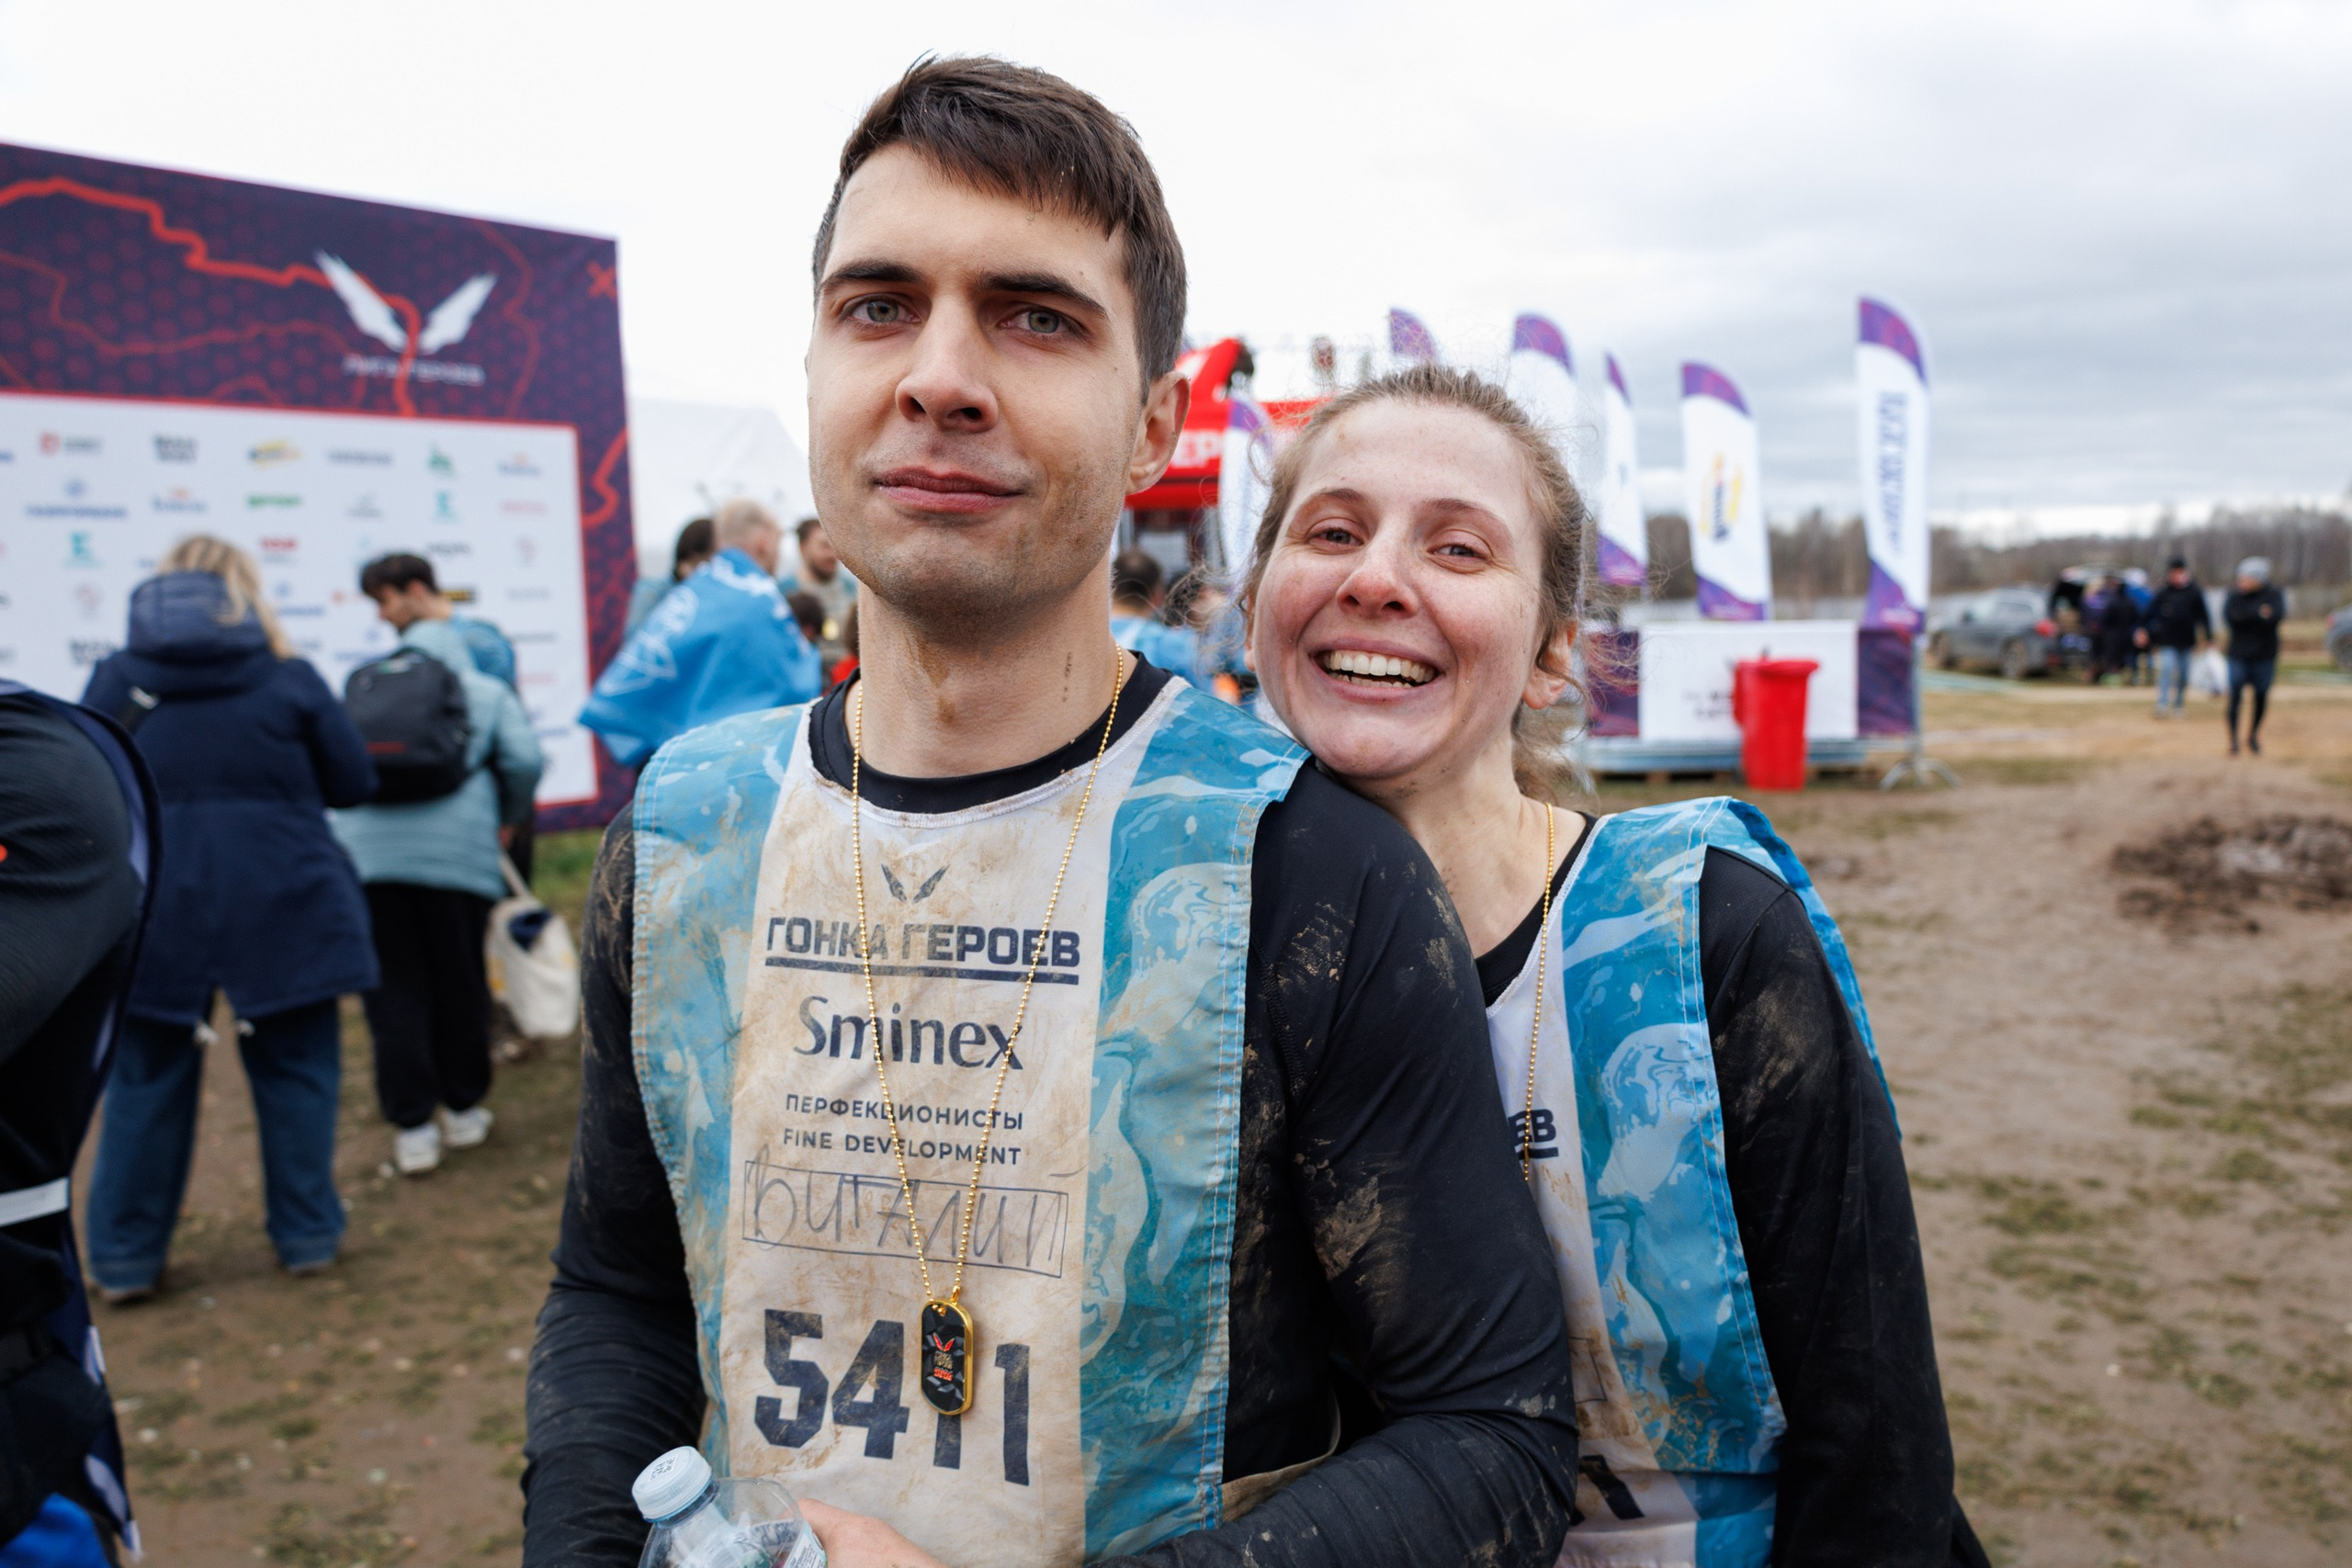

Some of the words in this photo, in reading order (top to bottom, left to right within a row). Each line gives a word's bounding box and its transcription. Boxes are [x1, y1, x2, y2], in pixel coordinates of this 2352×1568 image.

[766, 917, 888, 960] ГОНКА
[902, 923, 1080, 967] ГЕРОЕВ
[793, 995, 1023, 1070] Sminex
[786, 1093, 1023, 1130] ПЕРФЕКЦИОНИСТЫ
[784, 1128, 832, 1149] FINE
[845, 1134, 1021, 1165] DEVELOPMENT
